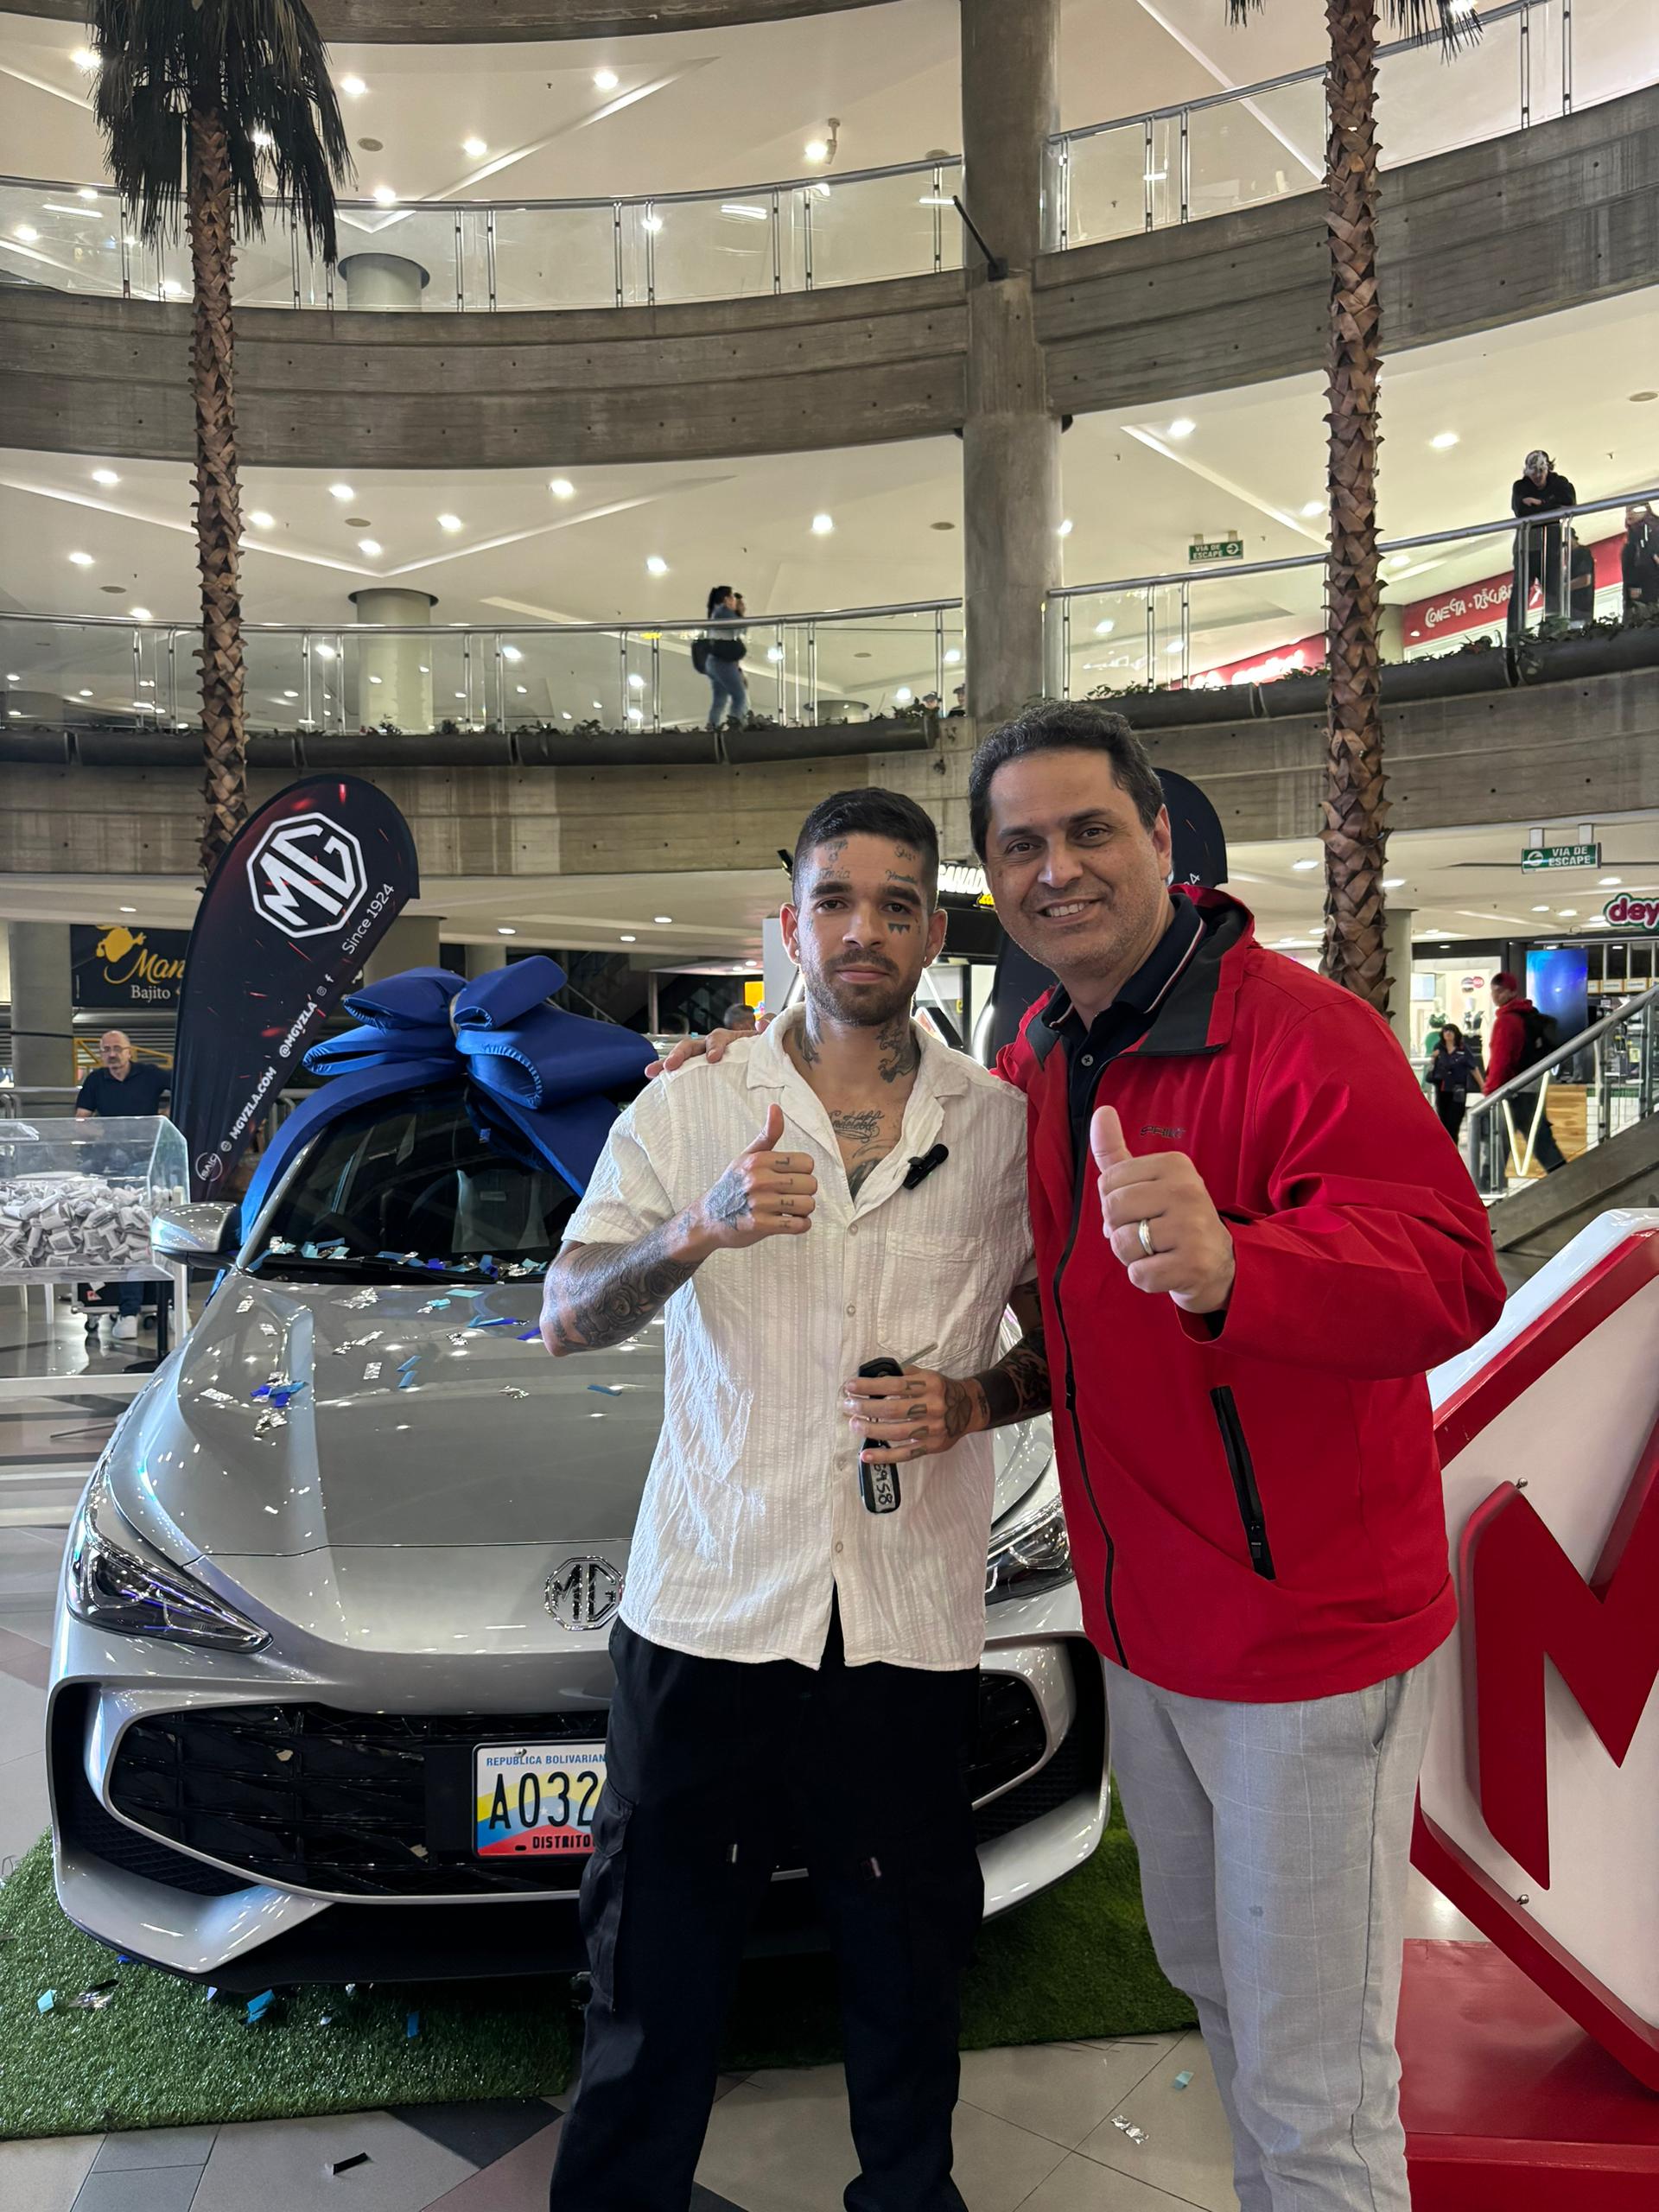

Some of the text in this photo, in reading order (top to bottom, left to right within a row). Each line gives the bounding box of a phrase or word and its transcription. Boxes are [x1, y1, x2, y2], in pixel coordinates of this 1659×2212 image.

[1193, 550, 1223, 559] ESCAPE
[1548, 855, 1591, 867] ESCAPE
[1552, 846, 1588, 856] VIA DE
[260, 824, 356, 926] MG
[342, 883, 395, 954] Since 1924
[131, 985, 171, 1002] Bajito
[279, 1001, 318, 1058] @MGVZLA
[229, 1066, 276, 1140] MGVZLA.COM
[550, 1563, 617, 1624] MG
[486, 1756, 542, 1766] REPUBLICA
[489, 1770, 599, 1829] A032
[533, 1834, 591, 1848] DISTRITO
